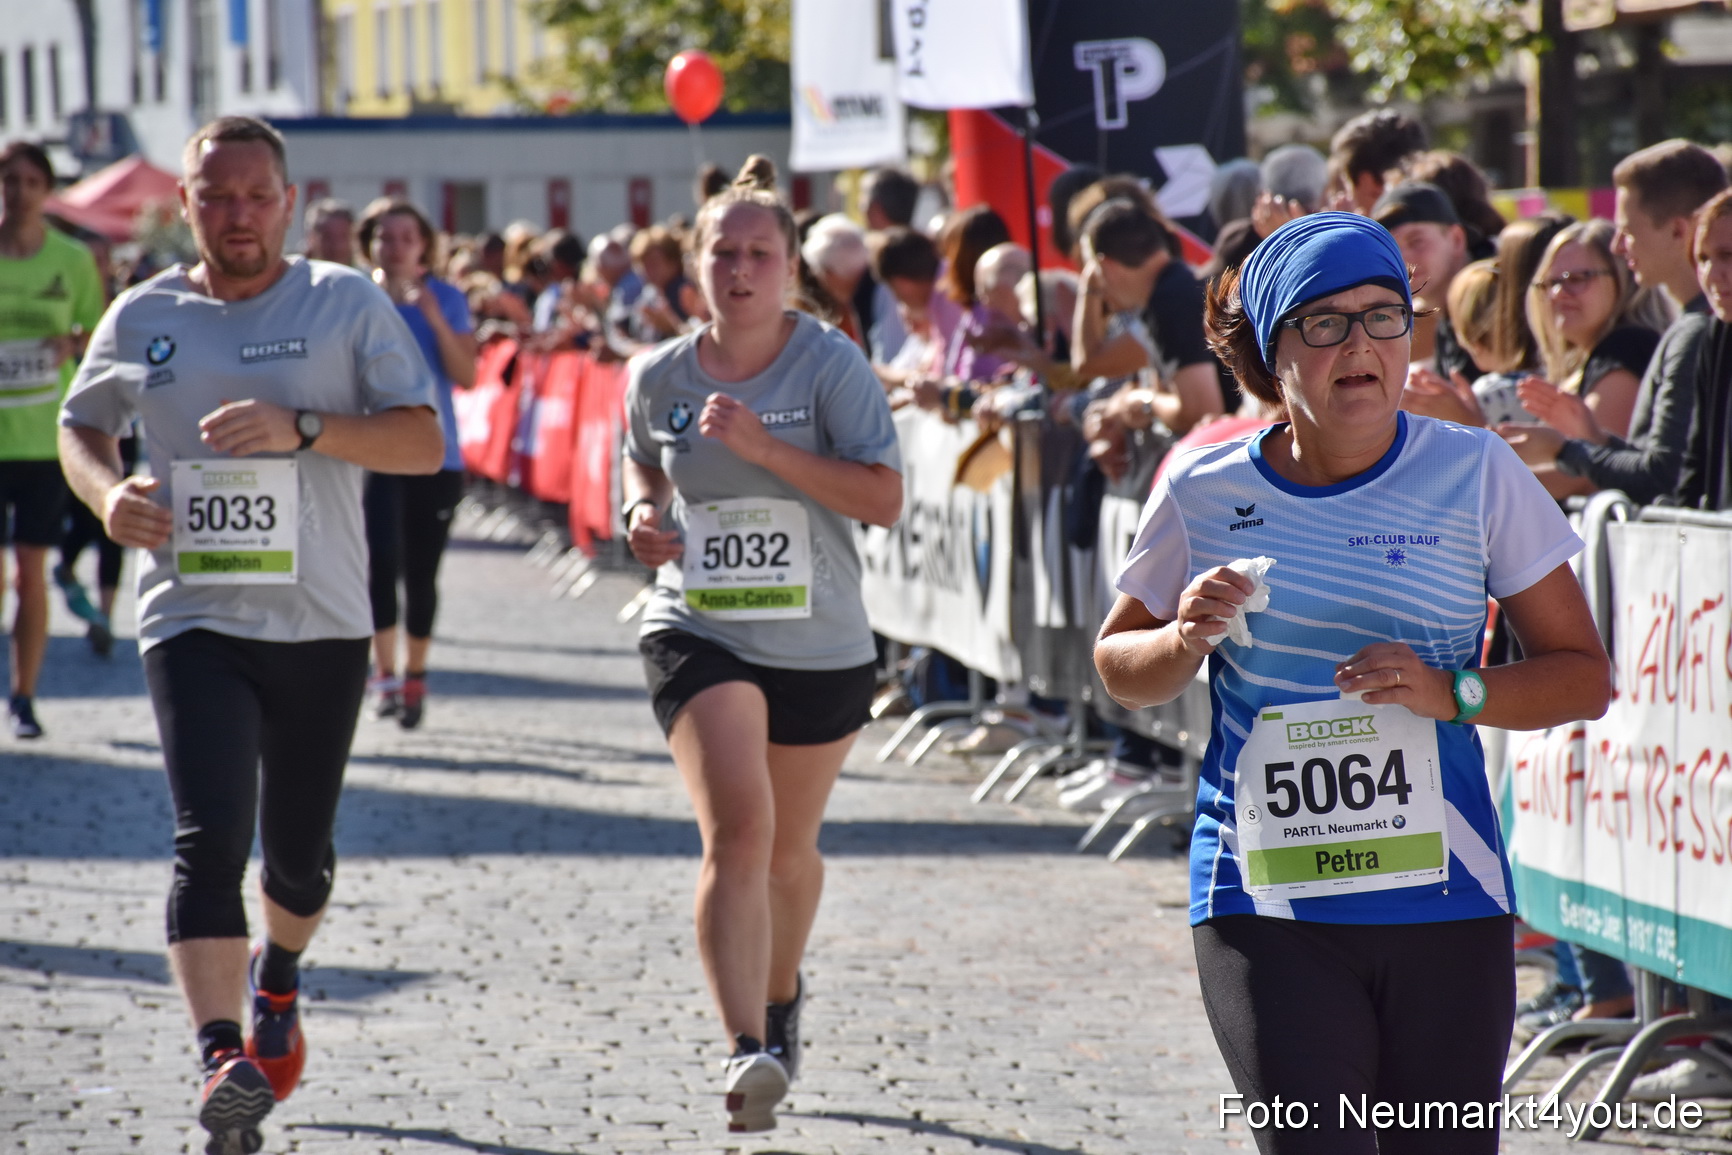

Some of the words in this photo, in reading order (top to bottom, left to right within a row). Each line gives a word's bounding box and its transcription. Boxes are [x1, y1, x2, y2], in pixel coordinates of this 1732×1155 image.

[241, 339, 306, 360] BOCK
[759, 406, 809, 426] OCK
[188, 495, 276, 532] 5033
[1229, 518, 1264, 532] erima
[1348, 534, 1406, 547] SKI-CLUB
[1409, 535, 1440, 546] LAUF
[702, 532, 791, 570] 5032
[200, 554, 262, 572] Stephan
[699, 590, 794, 608] Anna-Carina
[1286, 715, 1378, 743] BOCK
[1288, 741, 1316, 750] inspired
[1317, 740, 1326, 748] by
[1327, 738, 1348, 746] smart
[1349, 736, 1380, 745] concepts
[1264, 749, 1412, 819] 5064
[1643, 746, 1732, 865] BESS
[1283, 825, 1326, 838] PARTL
[1328, 820, 1388, 834] Neumarkt
[1315, 849, 1379, 874] Petra
